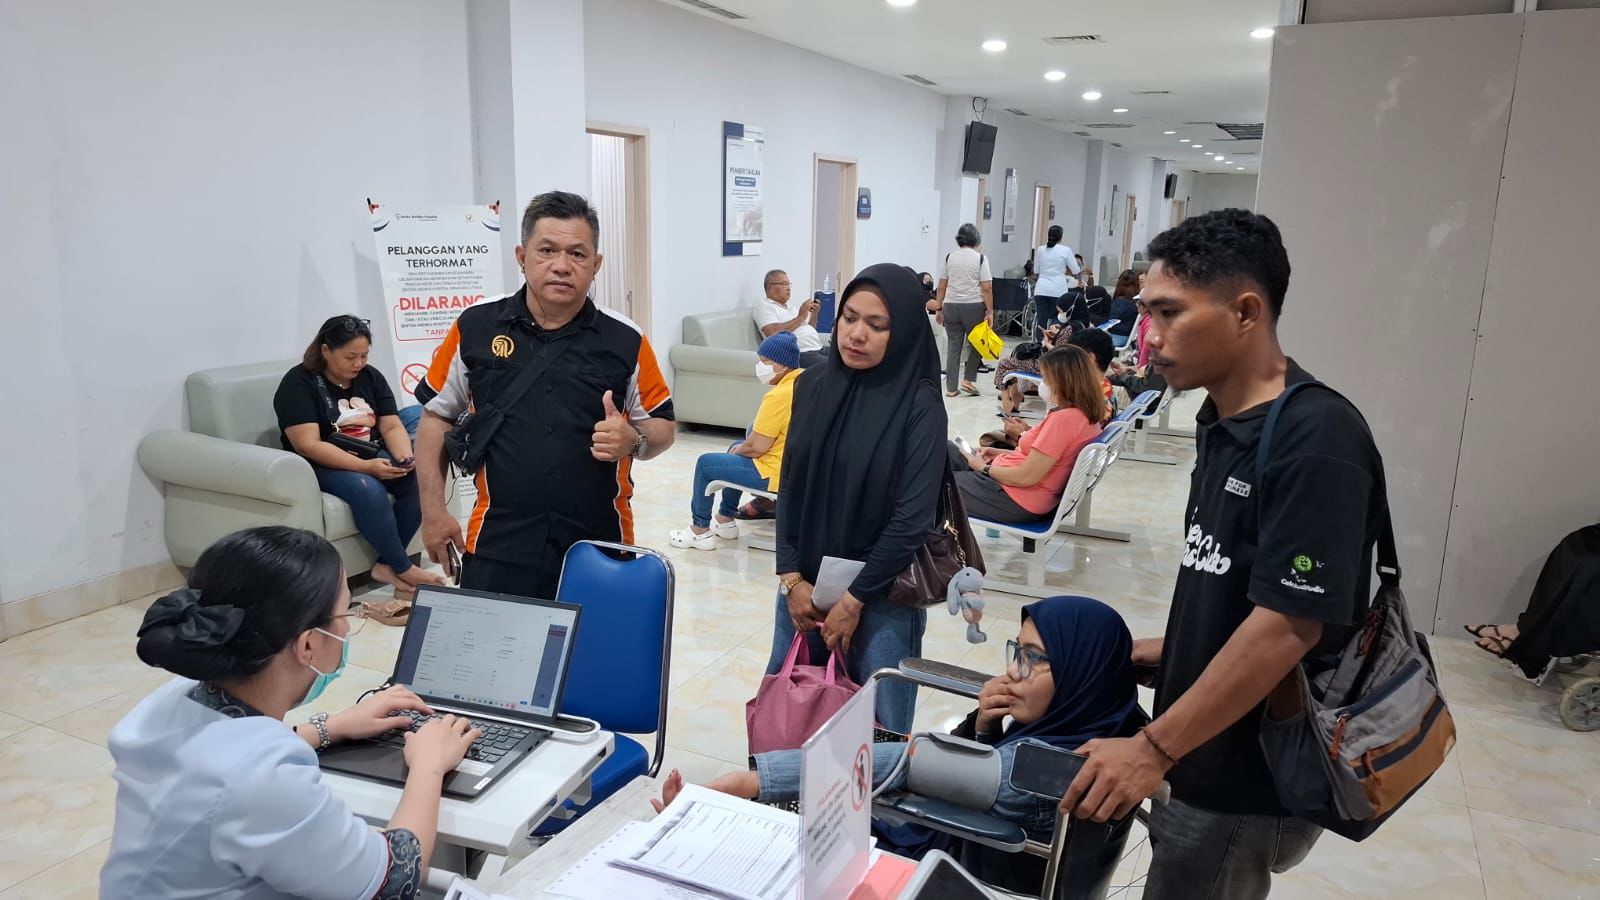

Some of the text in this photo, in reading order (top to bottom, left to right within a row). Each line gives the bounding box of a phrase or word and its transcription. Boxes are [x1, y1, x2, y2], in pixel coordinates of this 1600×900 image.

[387, 245, 489, 255] PELANGGAN YANG
[405, 258, 474, 268] TERHORMAT
